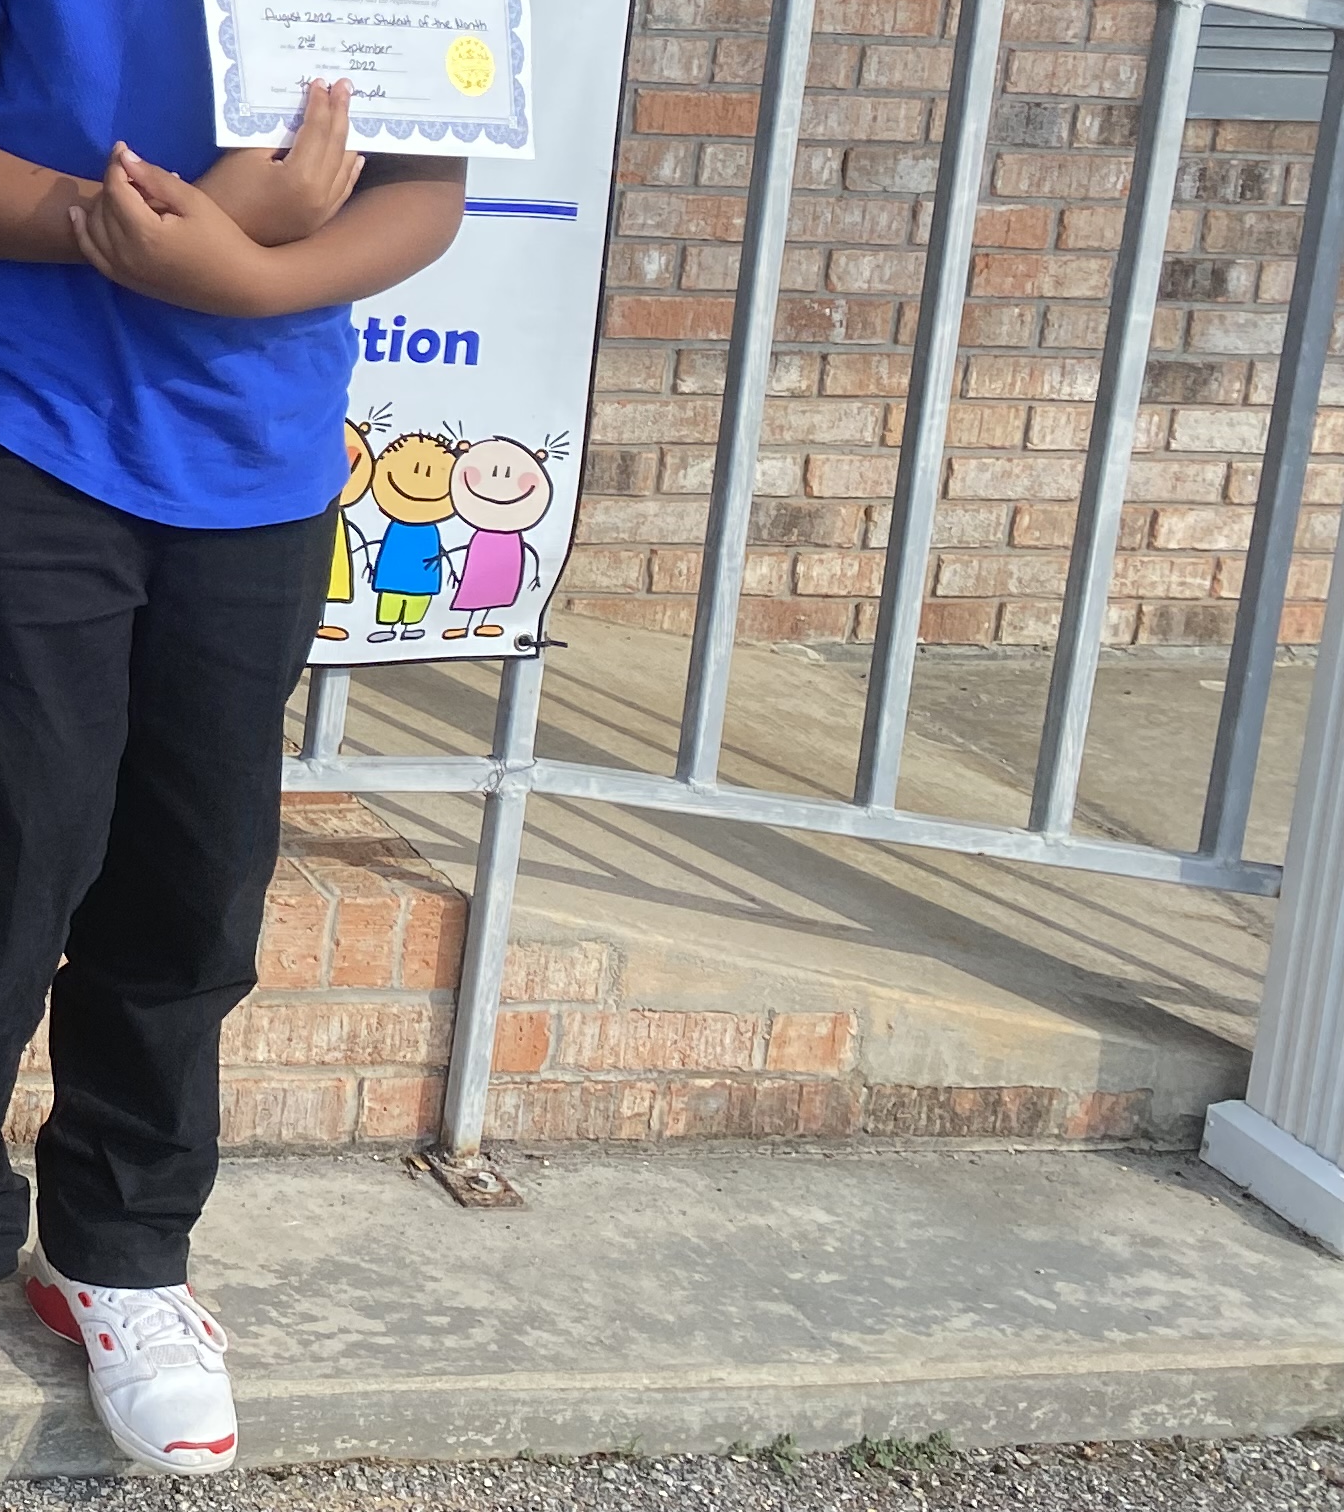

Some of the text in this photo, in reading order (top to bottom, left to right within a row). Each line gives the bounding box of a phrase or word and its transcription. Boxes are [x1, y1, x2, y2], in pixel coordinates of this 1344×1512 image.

[265, 7, 301, 28] August
[432, 17, 453, 29] the
[349, 59, 378, 71] 2022
[355, 315, 480, 366] tion
